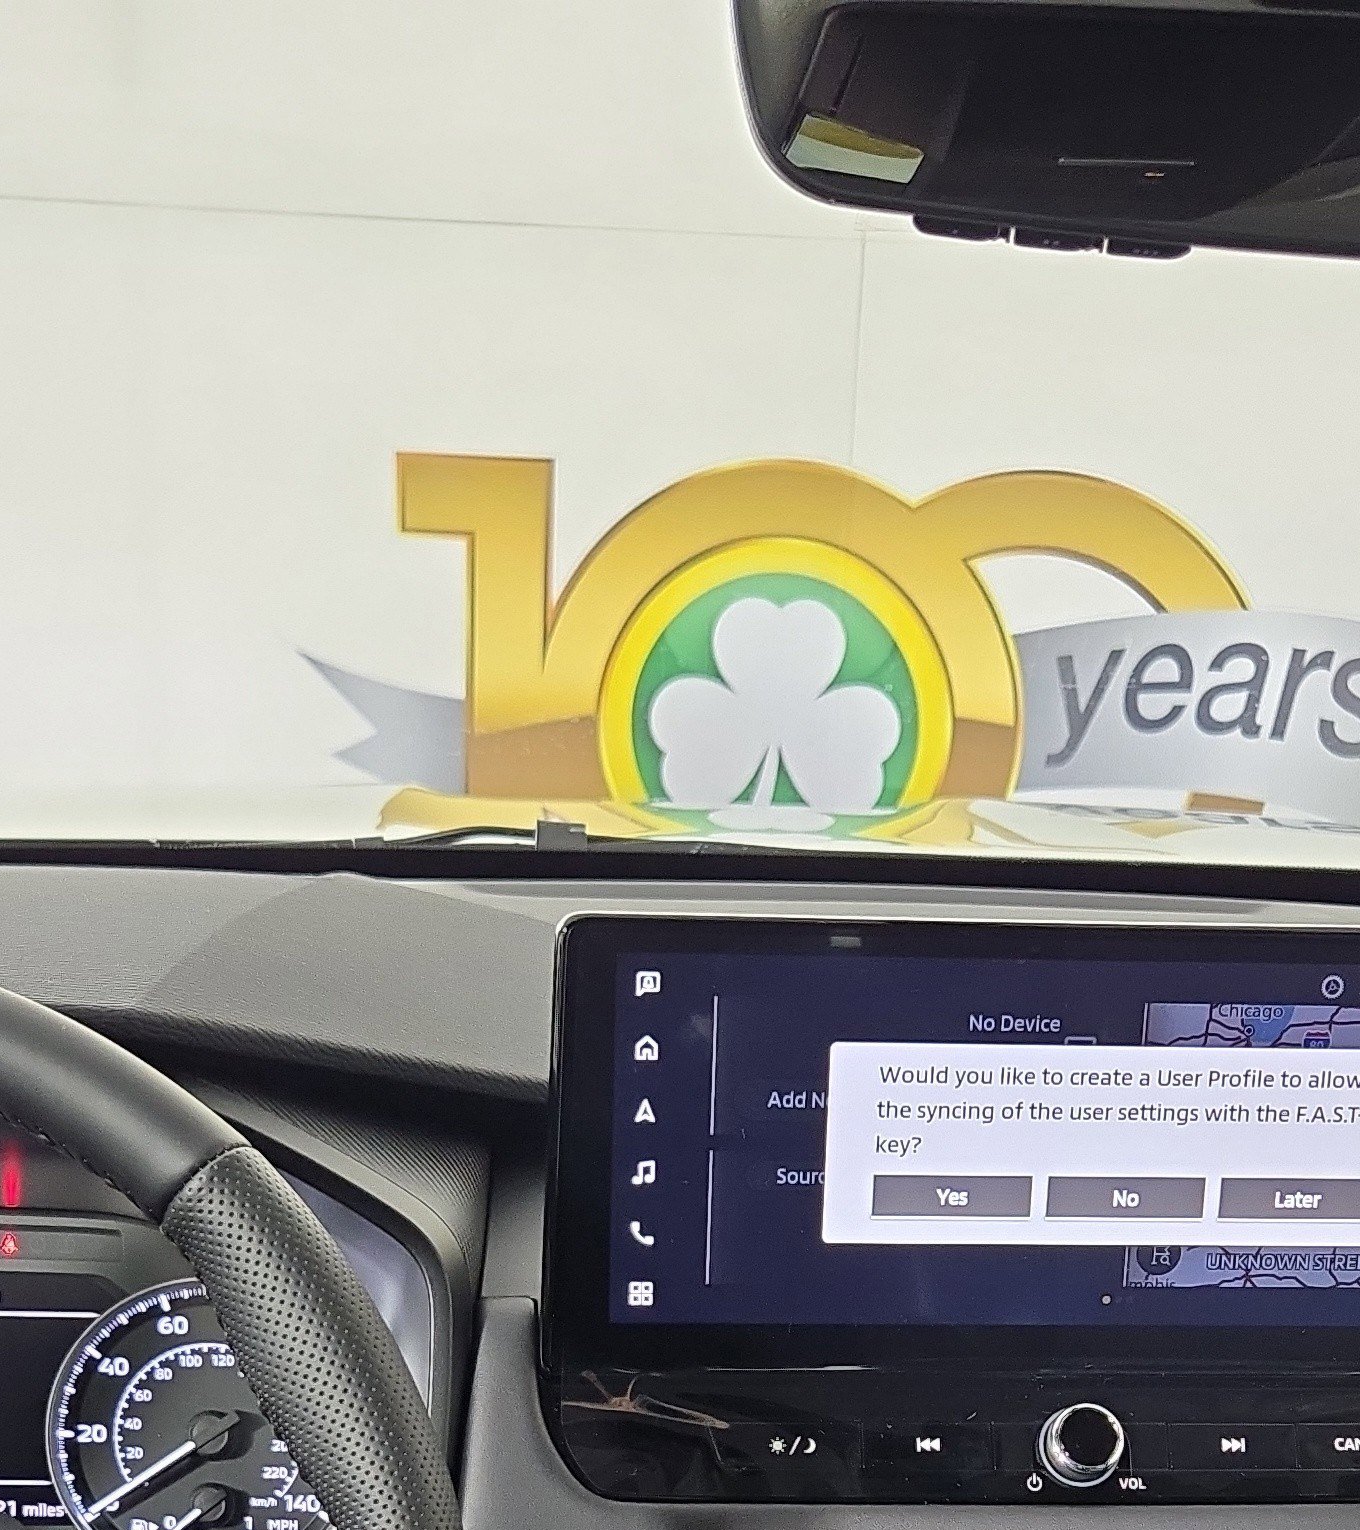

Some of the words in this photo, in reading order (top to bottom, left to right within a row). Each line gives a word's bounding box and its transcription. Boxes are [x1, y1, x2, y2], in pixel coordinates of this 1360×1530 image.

[1218, 1004, 1284, 1020] Chicago
[969, 1015, 995, 1031] No
[1001, 1015, 1061, 1032] Device
[880, 1067, 948, 1084] Would
[955, 1070, 993, 1089] you
[1001, 1067, 1035, 1085] like
[1042, 1068, 1063, 1085] to
[1070, 1068, 1133, 1085] create
[1139, 1073, 1150, 1086] a
[1158, 1070, 1202, 1087] User
[1208, 1069, 1274, 1087] Profile
[1281, 1071, 1302, 1087] to
[767, 1091, 806, 1108] Add
[811, 1092, 828, 1109] N
[877, 1101, 911, 1118] the
[917, 1102, 994, 1124] syncing
[1002, 1103, 1023, 1119] of
[1030, 1103, 1063, 1120] the
[1070, 1106, 1113, 1120] user
[1118, 1104, 1198, 1125] settings
[1205, 1105, 1250, 1122] with
[1257, 1105, 1289, 1122] the
[876, 1135, 922, 1157] key?
[936, 1188, 968, 1206] Yes
[1112, 1190, 1139, 1207] No
[1275, 1192, 1322, 1208] Later
[1206, 1253, 1310, 1271] UNKNOWN
[157, 1316, 189, 1335] 60
[97, 1357, 130, 1376] 40
[179, 1355, 202, 1367] 100
[212, 1355, 235, 1367] 120
[153, 1368, 172, 1380] 80
[134, 1390, 152, 1402] 60
[124, 1418, 142, 1430] 40
[76, 1424, 108, 1443] 20
[126, 1448, 143, 1459] 20
[262, 1467, 288, 1479] 220
[1119, 1478, 1147, 1490] VOL
[22, 1503, 65, 1517] miles
[284, 1494, 320, 1512] 140
[164, 1516, 176, 1528] 0
[244, 1516, 252, 1529] 1
[266, 1520, 298, 1530] MPH
